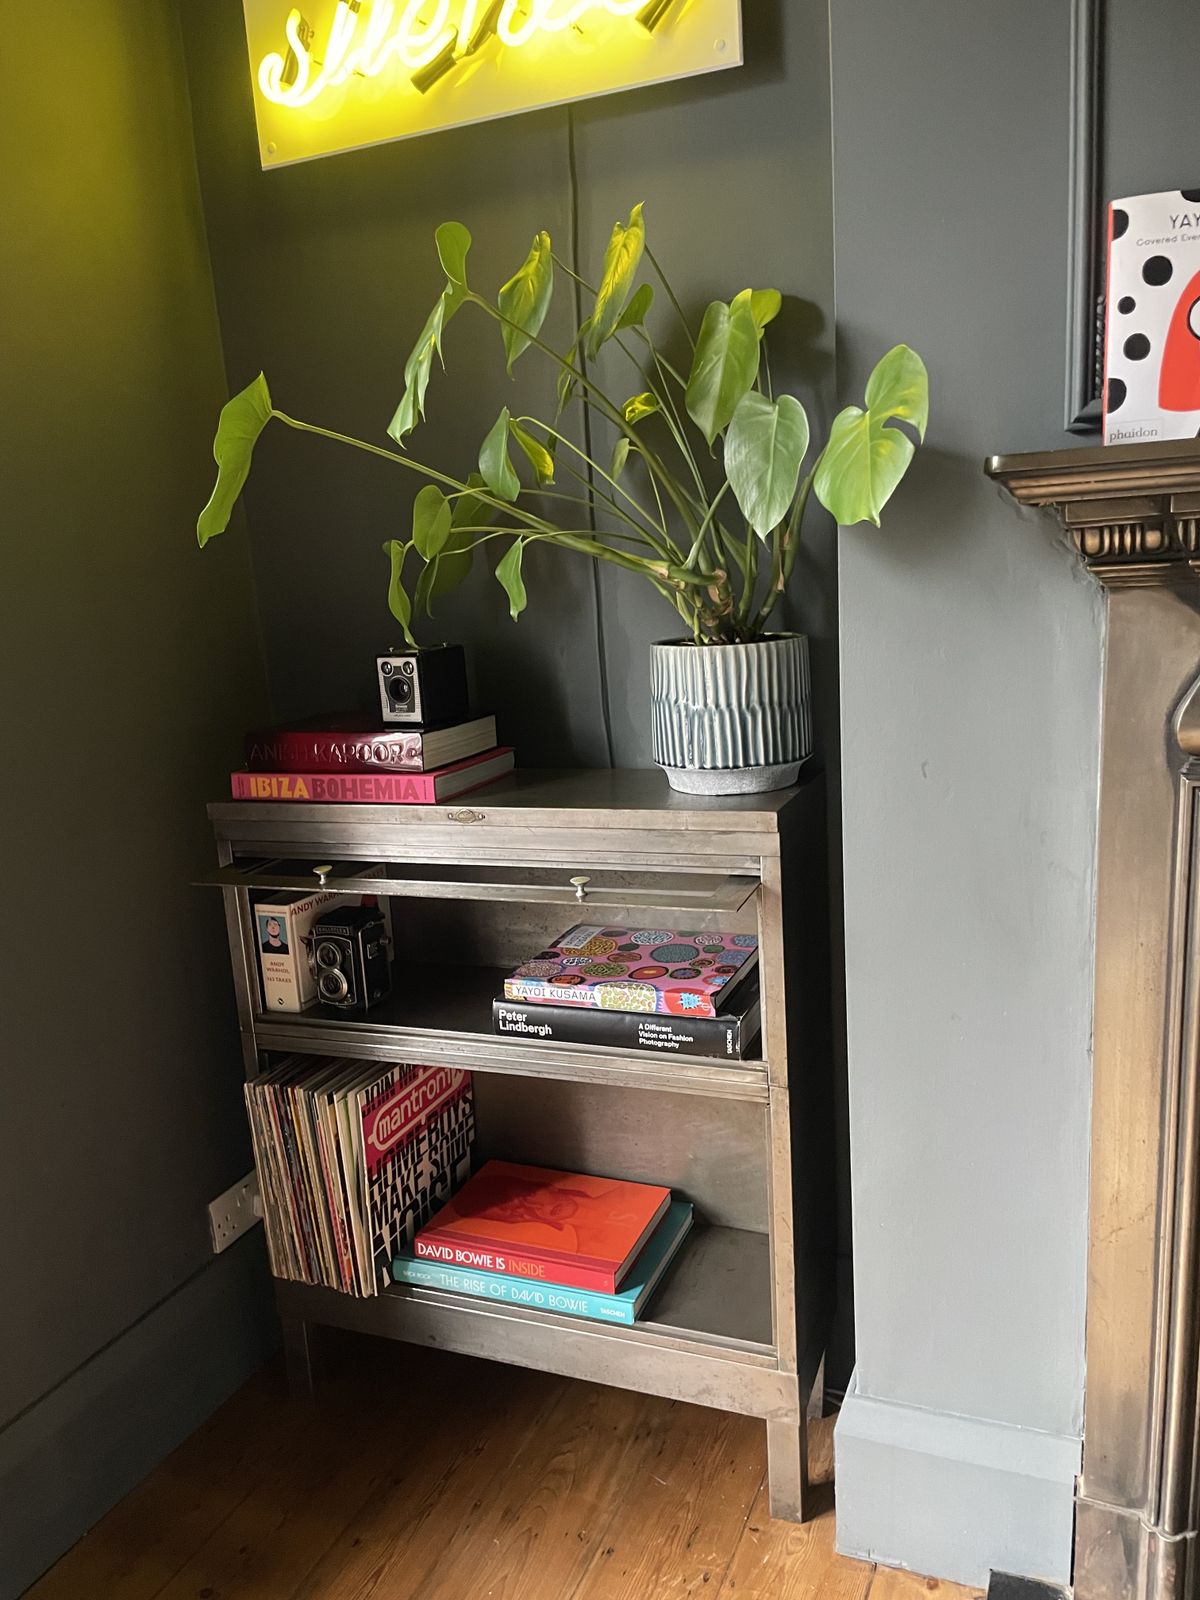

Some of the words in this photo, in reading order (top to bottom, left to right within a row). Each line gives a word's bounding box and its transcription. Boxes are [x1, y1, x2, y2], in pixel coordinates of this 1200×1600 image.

[1136, 235, 1177, 247] Covered
[1109, 427, 1158, 443] phaidon
[314, 743, 404, 764] KAPOOR
[250, 777, 310, 799] IBIZA
[311, 778, 421, 801] BOHEMIA
[290, 899, 313, 917] ANDY
[516, 986, 545, 997] YAYOI
[549, 988, 596, 1001] KUSAMA
[499, 1009, 527, 1022] Peter
[499, 1020, 552, 1036] Lindbergh
[644, 1024, 672, 1033] Different
[639, 1038, 679, 1049] Photography
[668, 1034, 693, 1042] Fashion
[370, 1156, 425, 1238] MAKE
[428, 1112, 475, 1182] SOME
[418, 1243, 453, 1260] DAVID
[456, 1249, 493, 1268] BOWIE
[496, 1256, 506, 1270] IS
[508, 1260, 545, 1277] INSIDE
[440, 1273, 459, 1288] THE
[464, 1278, 486, 1293] RISE
[490, 1283, 507, 1297] OF
[511, 1287, 544, 1304] DAVID
[549, 1294, 589, 1313] BOWIE
[600, 1307, 626, 1318] TASCHEN
